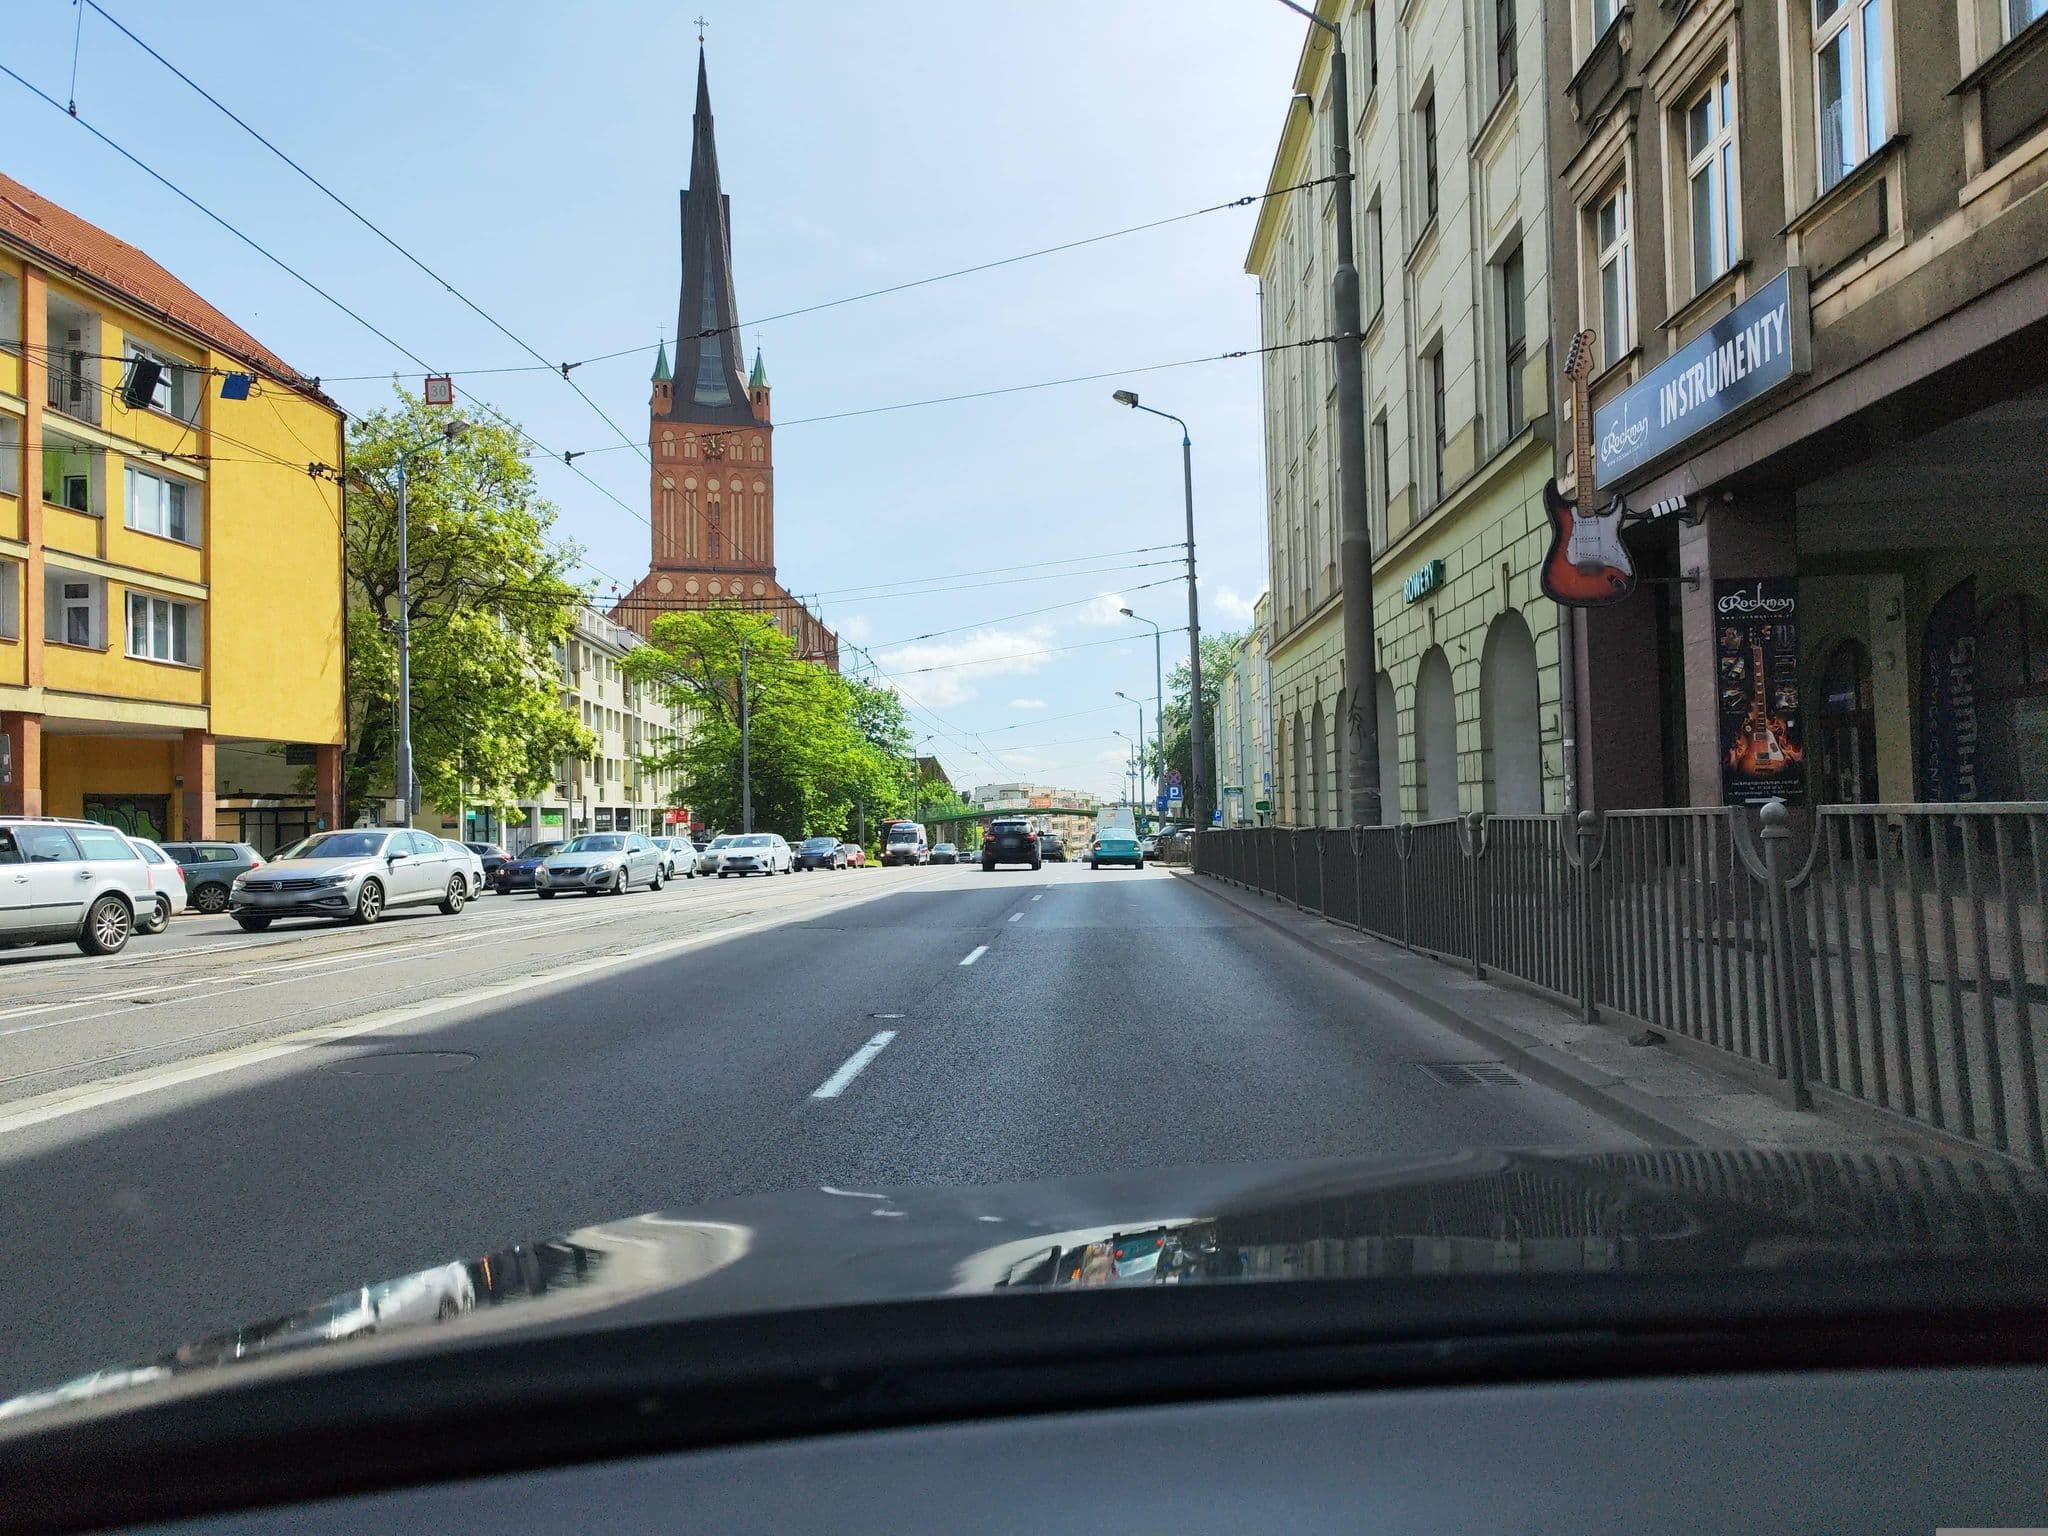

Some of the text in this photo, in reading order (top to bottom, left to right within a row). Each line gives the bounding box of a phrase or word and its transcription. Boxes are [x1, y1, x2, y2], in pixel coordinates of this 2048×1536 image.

[1660, 303, 1784, 428] INSTRUMENTY
[430, 384, 447, 398] 30
[1601, 402, 1648, 462] Rockman
[1403, 561, 1433, 604] ROWERY
[1718, 582, 1794, 613] Rockman
[1949, 636, 1977, 803] SHIMAN
[1170, 786, 1179, 799] P
